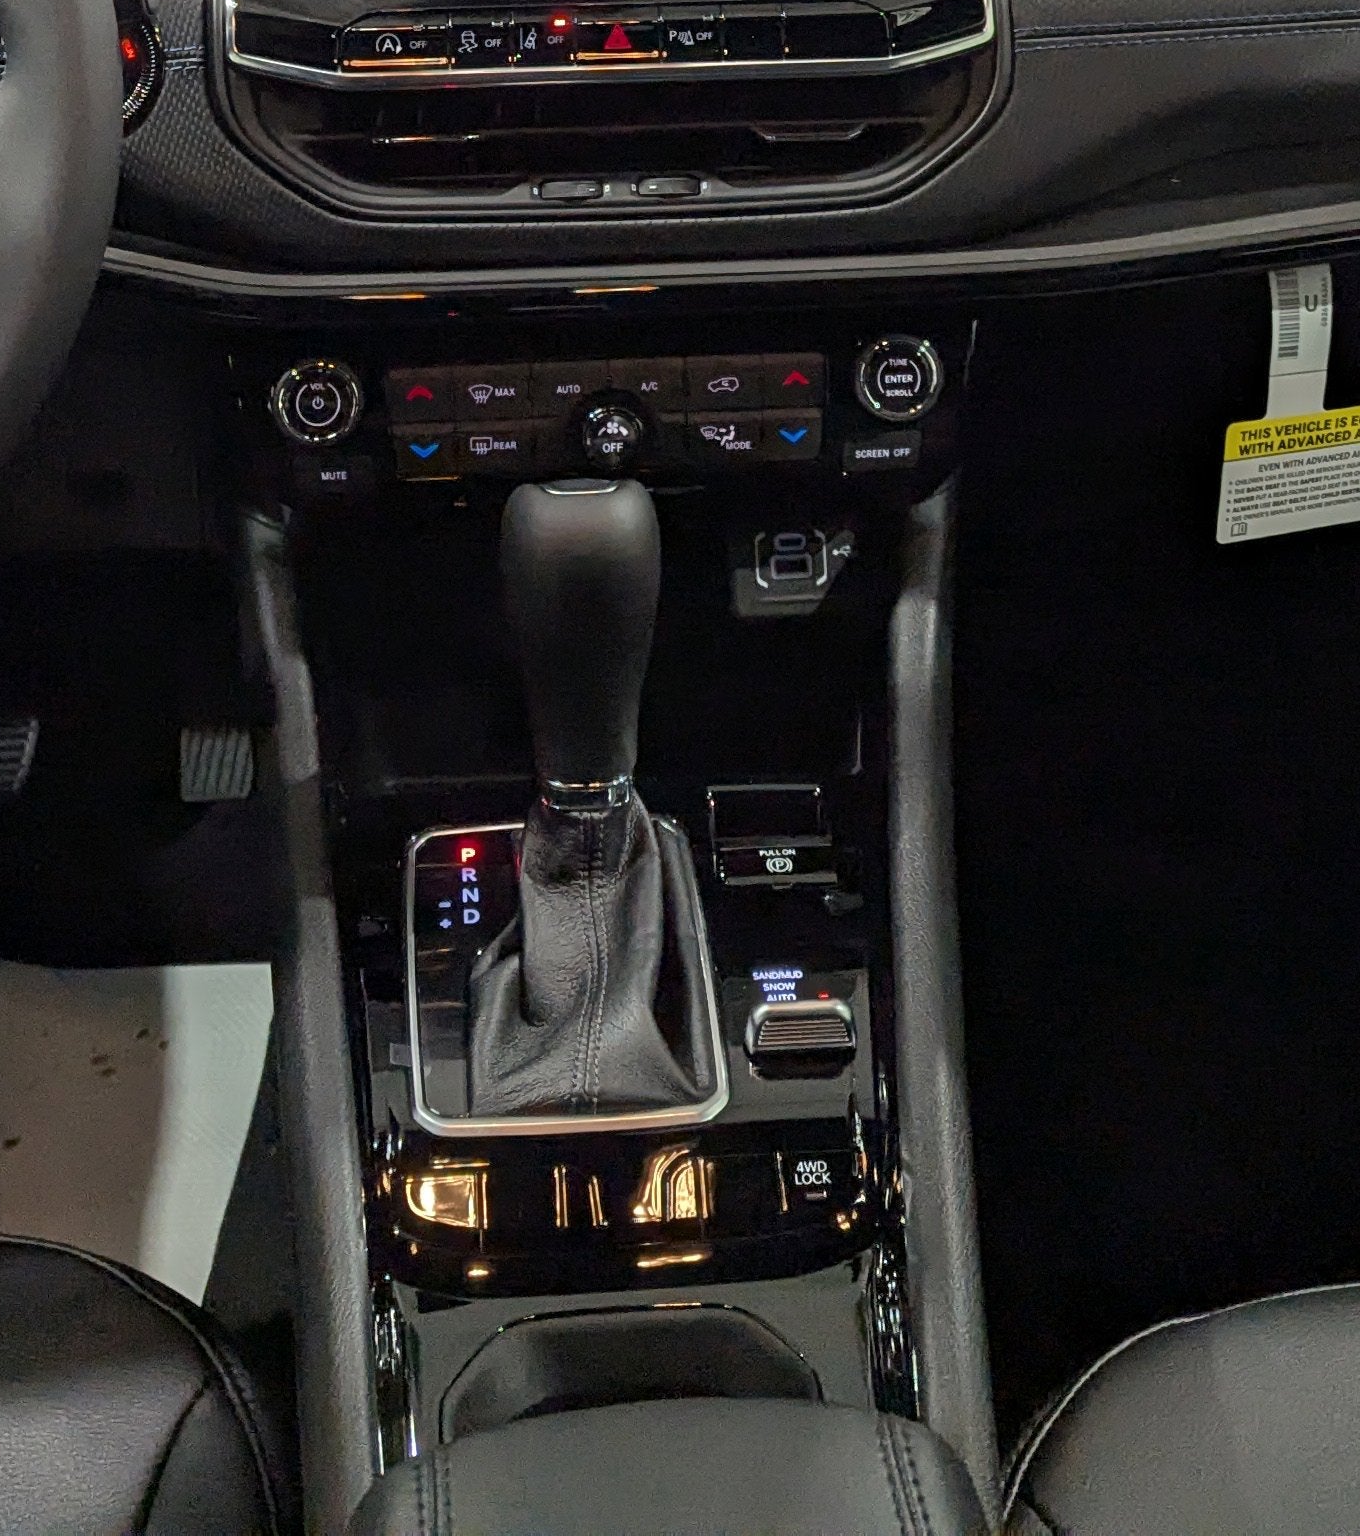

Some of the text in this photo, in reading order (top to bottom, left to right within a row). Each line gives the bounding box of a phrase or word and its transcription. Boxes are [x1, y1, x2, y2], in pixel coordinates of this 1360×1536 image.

[547, 36, 565, 45] OFF
[695, 31, 713, 42] OFF
[409, 40, 428, 49] OFF
[484, 38, 502, 48] OFF
[1304, 294, 1318, 313] U
[888, 358, 909, 367] TUNE
[884, 374, 914, 384] ENTER
[494, 387, 516, 397] MAX
[556, 384, 581, 394] AUTO
[640, 381, 658, 392] A/C
[885, 389, 914, 397] SCROLL
[1240, 428, 1271, 442] THIS
[1275, 420, 1332, 436] VEHICLE
[1334, 416, 1348, 429] IS
[602, 442, 624, 454] OFF
[725, 441, 753, 450] MODE
[1238, 440, 1274, 456] WITH
[1277, 430, 1351, 451] ADVANCED
[855, 447, 911, 459] SCREEN OFF
[1258, 462, 1280, 473] EVEN
[1282, 458, 1304, 469] WITH
[1305, 451, 1351, 465] ADVANCED
[321, 471, 348, 481] MUTE
[461, 847, 476, 863] P
[758, 848, 796, 857] PULL ON
[461, 867, 478, 882] R
[462, 887, 479, 903] N
[463, 908, 480, 924] D
[752, 970, 803, 981] SAND/MUD
[762, 982, 796, 992] SNOW
[766, 993, 797, 1002] AUTO
[796, 1160, 828, 1173] 4WD
[794, 1172, 832, 1186] LOCK
